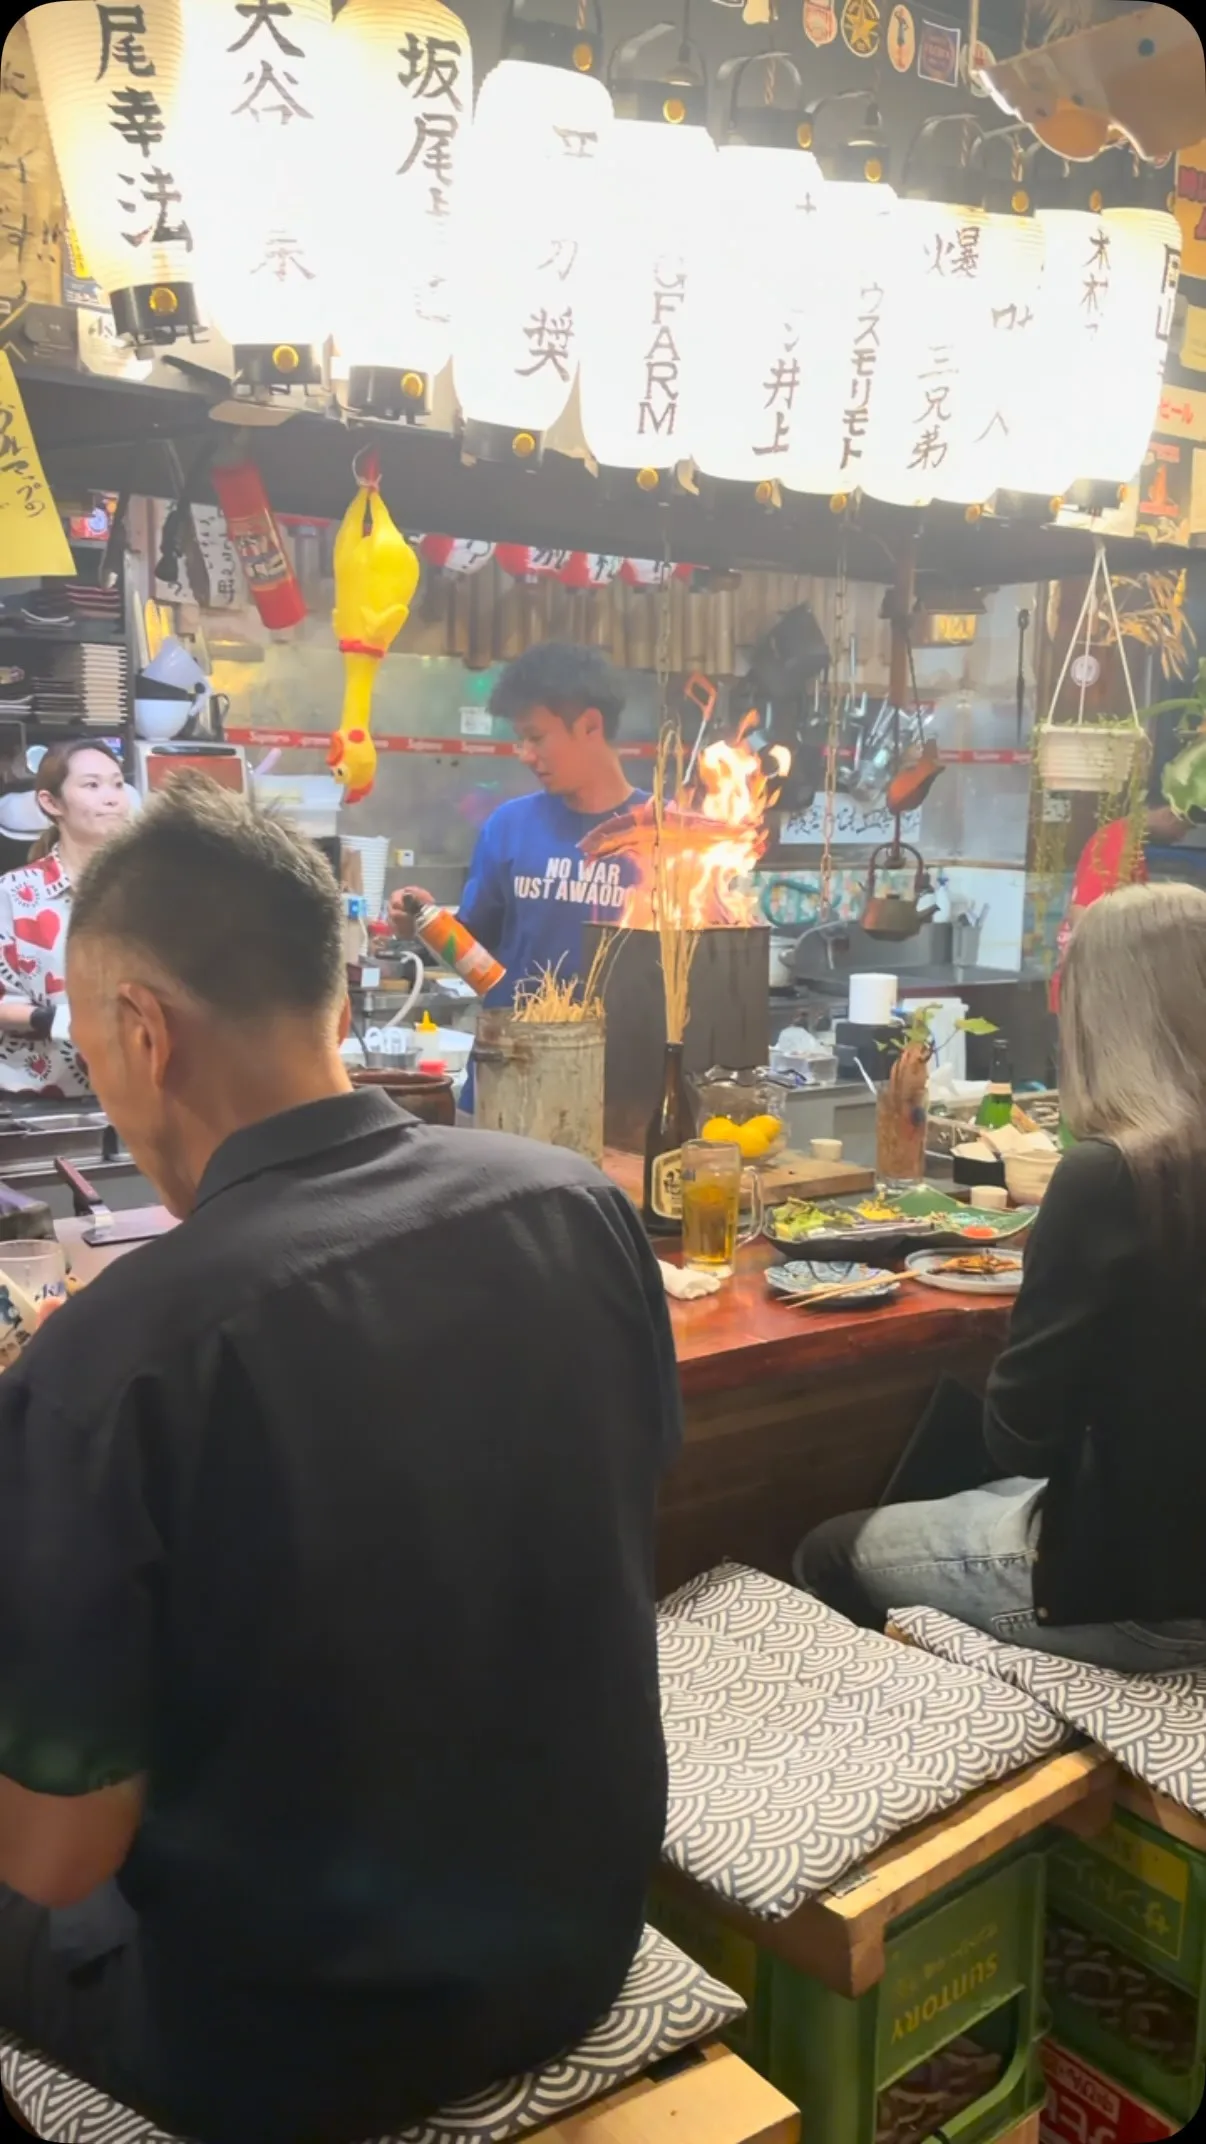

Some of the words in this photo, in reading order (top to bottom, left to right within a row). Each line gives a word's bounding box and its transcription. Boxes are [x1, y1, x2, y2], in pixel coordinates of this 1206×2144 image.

[545, 857, 573, 879] NO
[578, 859, 621, 885] WAR
[890, 1952, 998, 2045] SUNTORY
